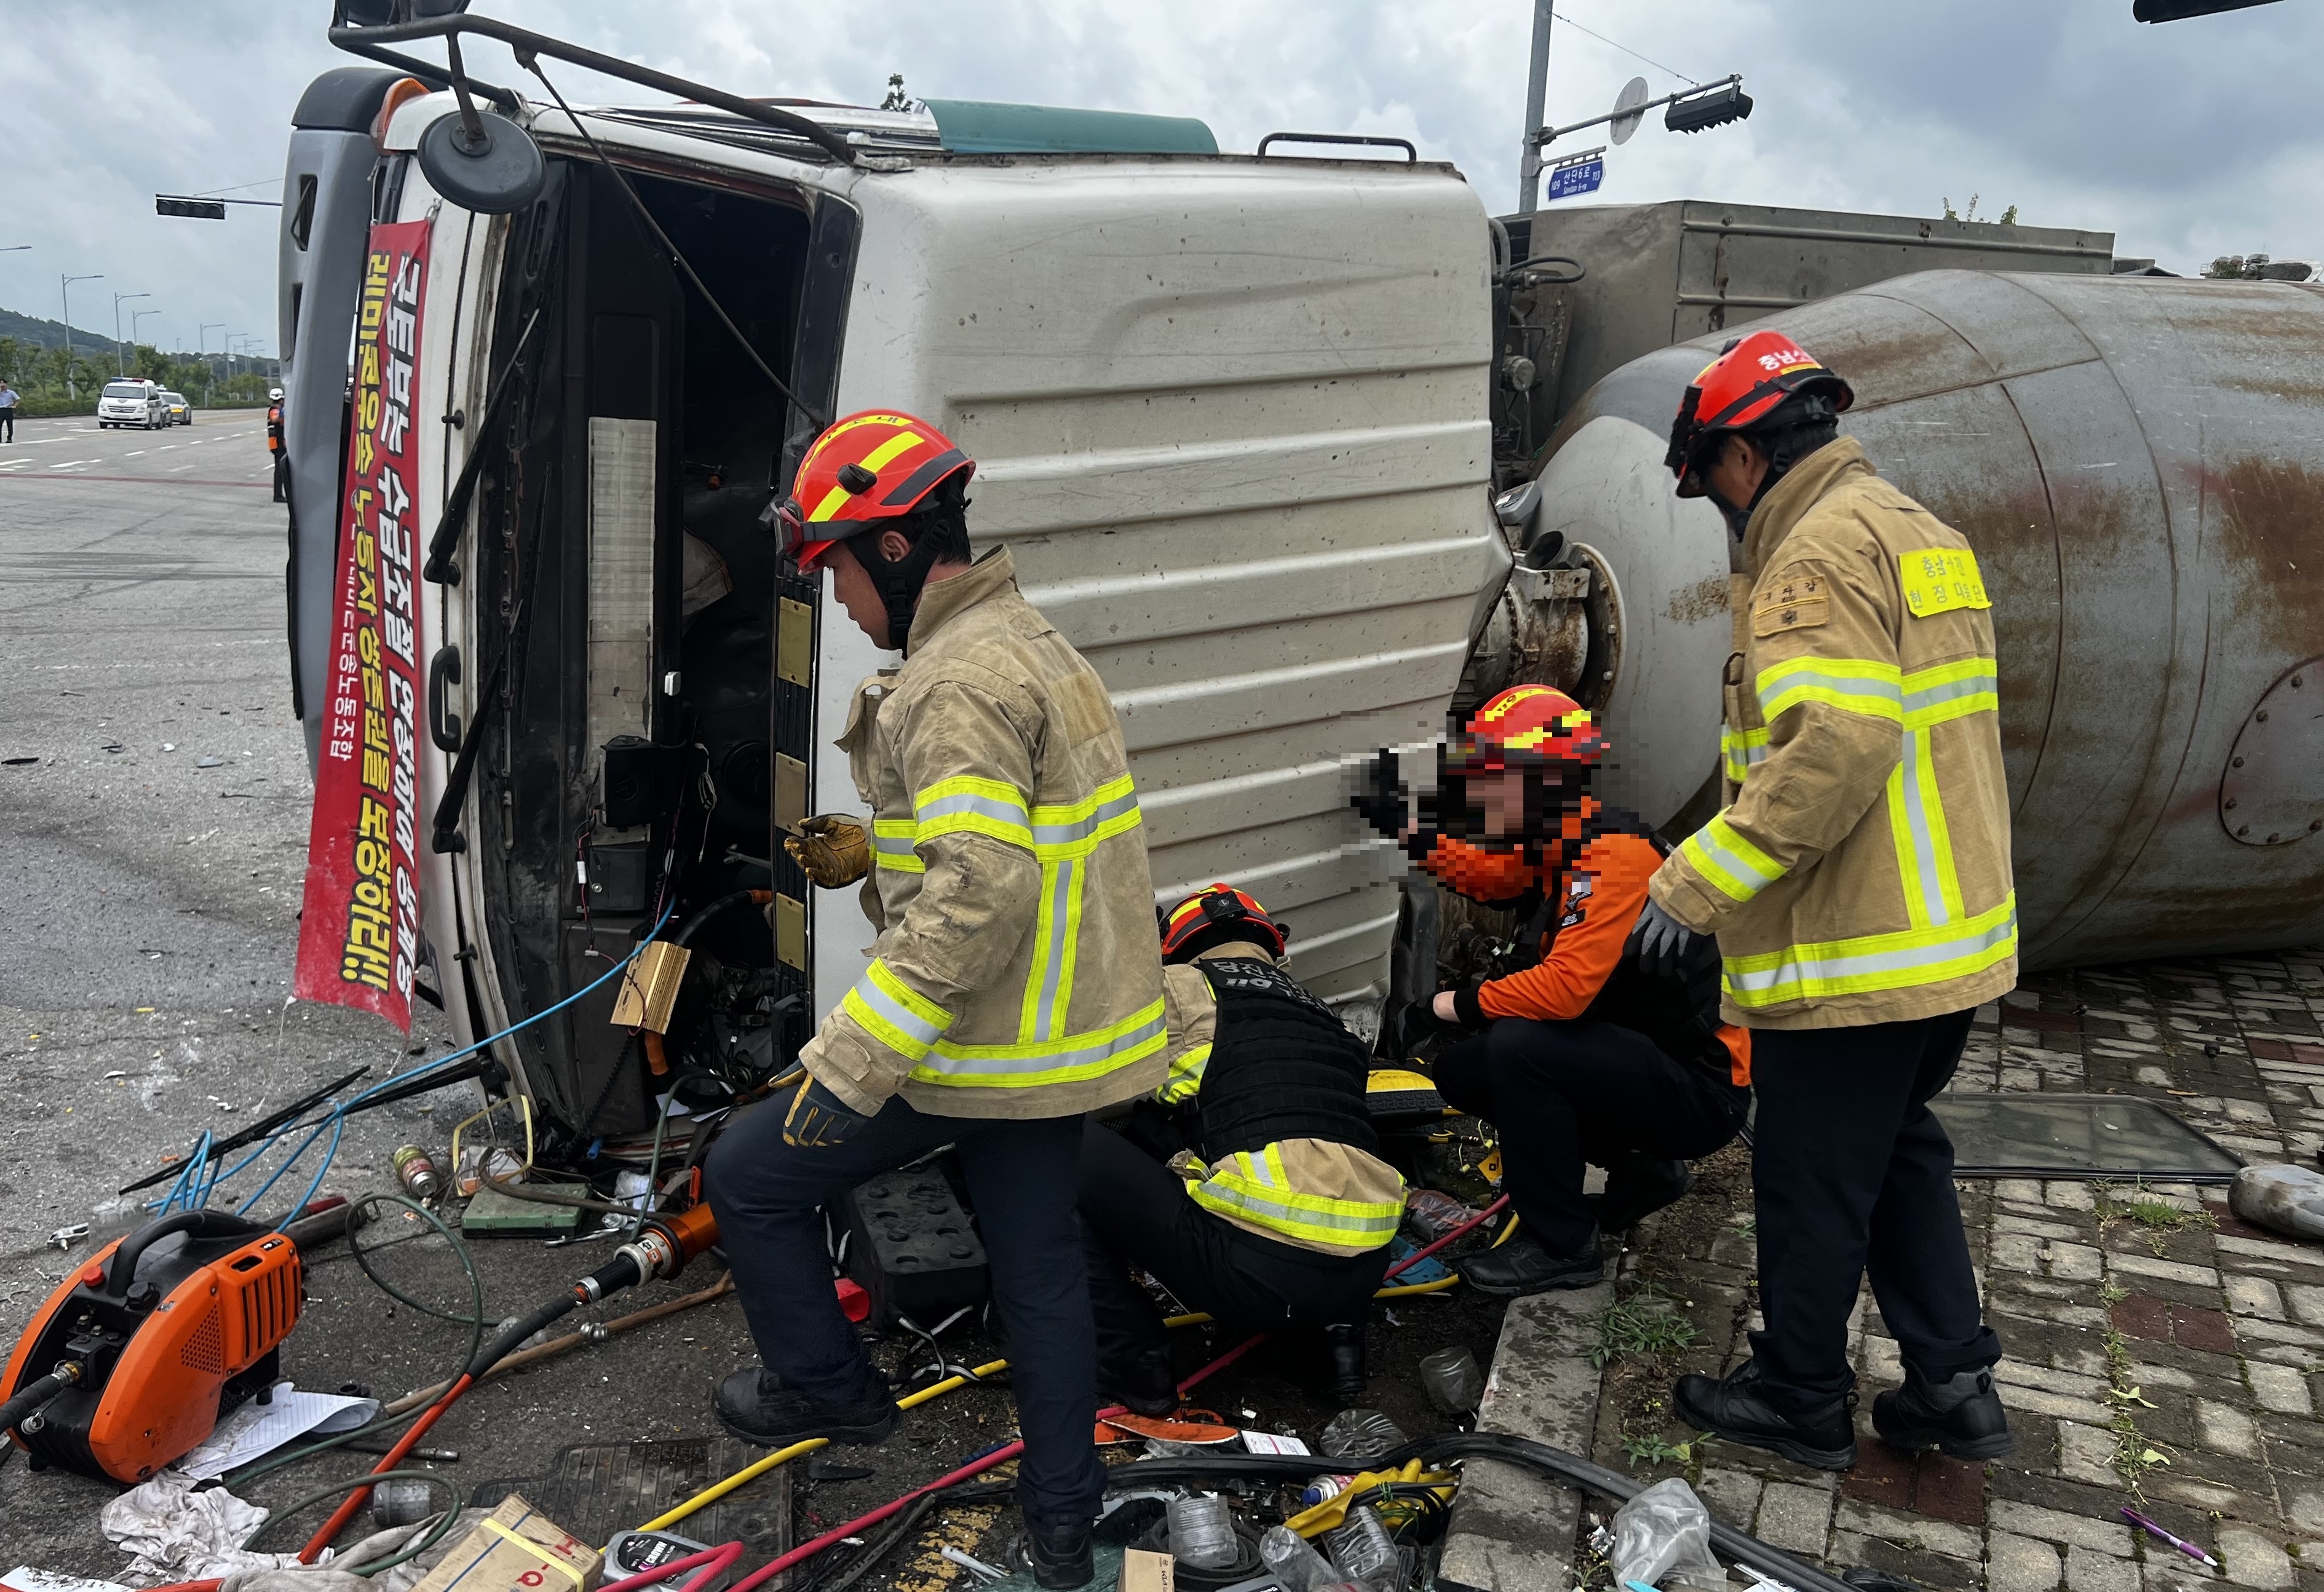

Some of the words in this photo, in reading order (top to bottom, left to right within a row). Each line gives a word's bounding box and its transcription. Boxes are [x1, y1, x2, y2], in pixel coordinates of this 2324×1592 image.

[1551, 180, 1561, 191] 109
[1563, 166, 1590, 184] 산단6로
[354, 254, 389, 475] 레미콘운송
[379, 255, 421, 454] 국토부는
[355, 490, 376, 615] 노동자
[378, 466, 414, 669] 수급조절
[360, 626, 390, 793] 생존권을
[388, 669, 415, 869] 연장하여
[341, 798, 391, 991] 보장하라!!
[645, 1540, 667, 1563] CROWN
